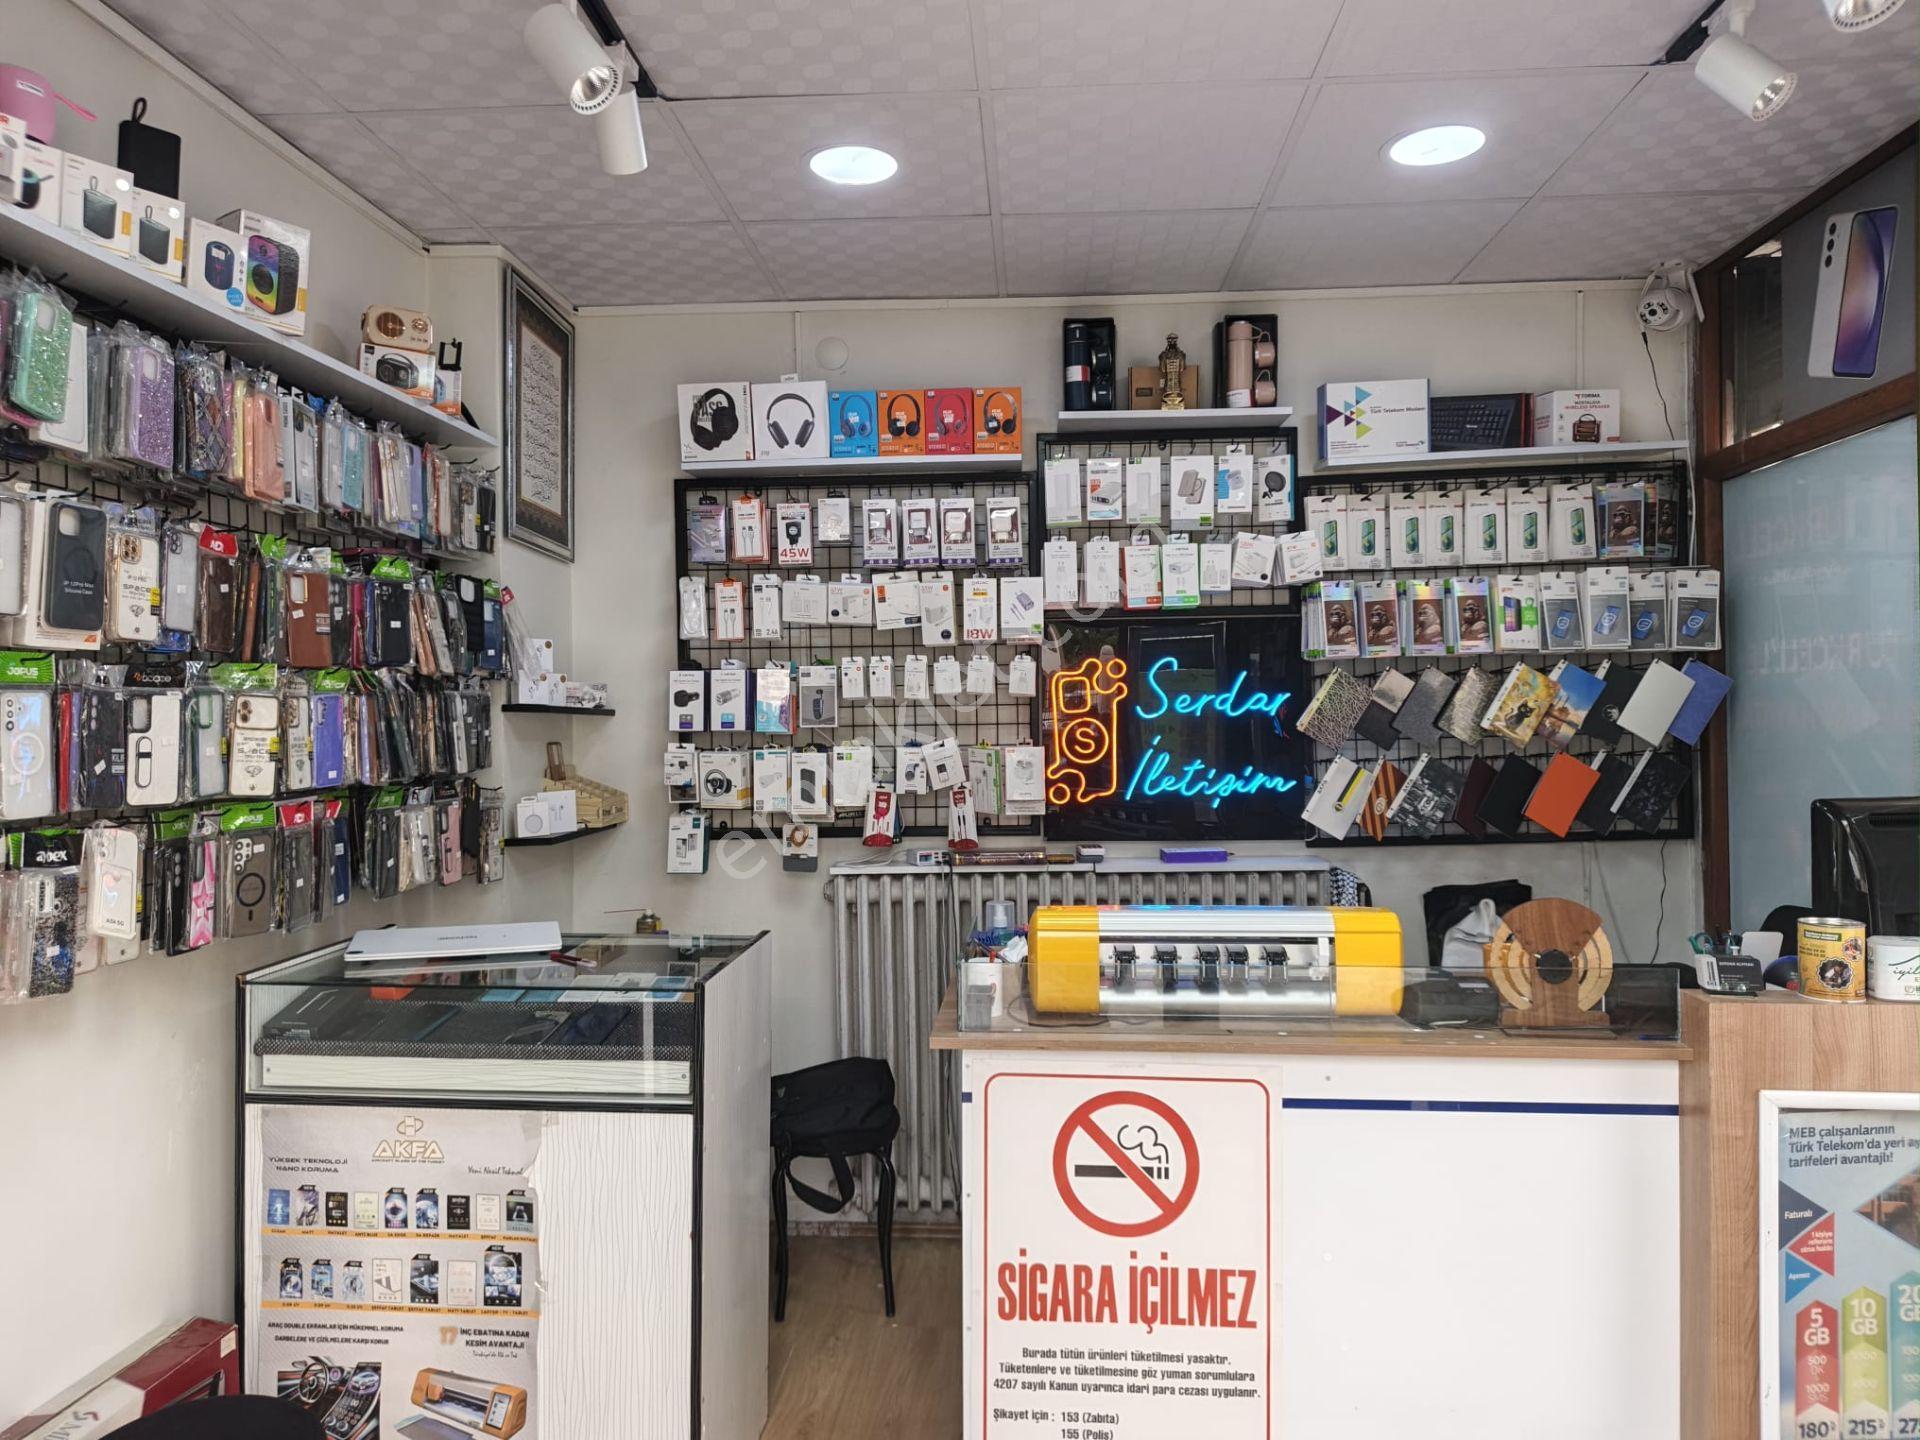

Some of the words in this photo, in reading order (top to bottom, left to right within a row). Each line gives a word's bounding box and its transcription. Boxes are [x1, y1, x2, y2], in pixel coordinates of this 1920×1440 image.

[780, 547, 810, 558] 45W
[1135, 656, 1292, 719] Serdar
[1074, 726, 1097, 754] S
[1125, 734, 1298, 810] İletişim
[1788, 1126, 1816, 1139] MEB
[1818, 1124, 1895, 1139] çalışanlarının
[372, 1139, 445, 1159] AKFA
[1788, 1140, 1813, 1153] Türk
[1816, 1138, 1881, 1151] Telekom'da
[1884, 1137, 1905, 1150] yeri
[269, 1156, 301, 1164] YÜKSEK
[303, 1157, 348, 1165] TEKNOLOJİ
[1788, 1155, 1838, 1168] tarifeleri
[1840, 1151, 1894, 1166] avantajlı!
[301, 1166, 339, 1174] KORUMA
[467, 1166, 482, 1174] Yeni
[483, 1165, 501, 1175] Nesil
[997, 1247, 1119, 1323] SİGARA
[1128, 1250, 1258, 1334] İÇİLMEZ
[1850, 1298, 1877, 1318] 10
[1809, 1307, 1823, 1328] 5
[336, 1323, 348, 1331] İÇİN
[349, 1324, 380, 1332] MÜKEMMEL
[473, 1328, 504, 1337] EBATINA
[505, 1329, 530, 1338] KADAR
[1850, 1318, 1879, 1336] GB
[465, 1339, 487, 1347] KESİM
[488, 1340, 525, 1349] AVANTAJI
[1803, 1327, 1831, 1346] GB
[1021, 1347, 1058, 1359] Burada
[1059, 1348, 1085, 1360] tütün
[1087, 1348, 1128, 1361] ürünleri
[1130, 1350, 1184, 1363] tüketilmesi
[1187, 1353, 1232, 1366] yasaktır.
[998, 1362, 1057, 1375] Tüketenlere
[1059, 1366, 1071, 1375] ve
[1073, 1365, 1139, 1378] tüketilmesine
[1141, 1366, 1157, 1379] göz
[1160, 1369, 1192, 1381] yuman
[1194, 1369, 1256, 1382] sorumlulara
[993, 1378, 1018, 1389] 4207
[1021, 1380, 1046, 1392] sayılı
[1049, 1380, 1079, 1391] Kanun
[1081, 1382, 1124, 1394] uyarınca
[1126, 1382, 1149, 1394] idari
[1152, 1385, 1176, 1397] para
[1178, 1385, 1210, 1397] cezası
[1211, 1386, 1261, 1399] uygulanır.
[992, 1407, 1030, 1422] Şikayet
[1031, 1409, 1050, 1423] için
[1060, 1411, 1080, 1423] 153
[1082, 1412, 1120, 1425] (Zabıta)
[1060, 1428, 1080, 1440] 155
[1798, 1421, 1830, 1438] 180
[1849, 1418, 1877, 1436] 215
